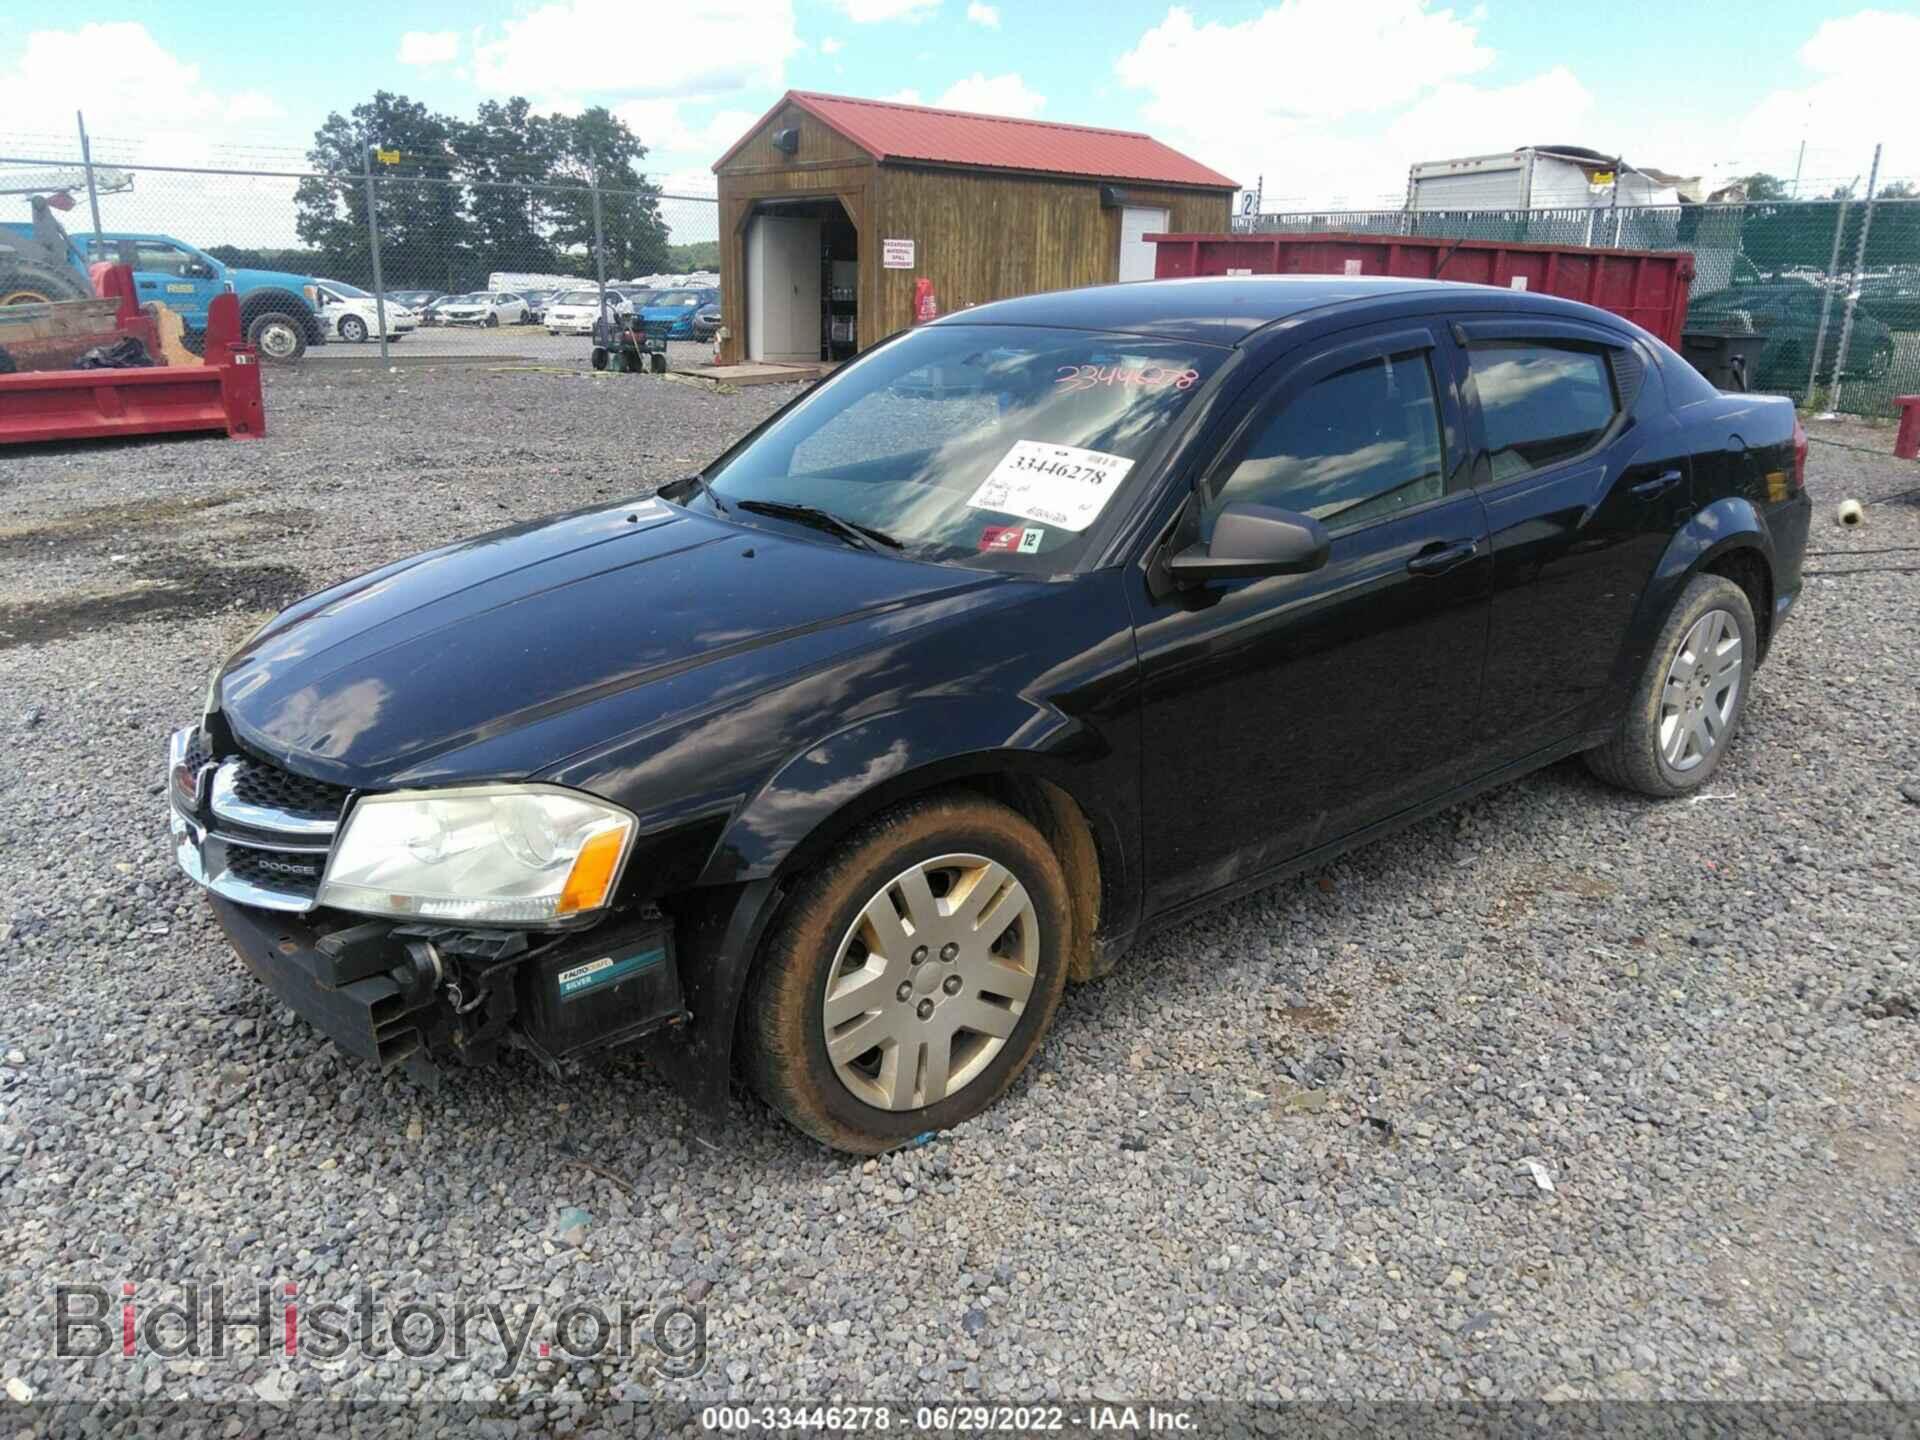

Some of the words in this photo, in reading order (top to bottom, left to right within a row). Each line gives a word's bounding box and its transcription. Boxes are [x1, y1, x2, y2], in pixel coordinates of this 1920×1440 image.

[1244, 193, 1253, 216] 2
[1010, 455, 1107, 486] 33446278
[1023, 533, 1037, 547] 12
[258, 860, 316, 876] DODGE
